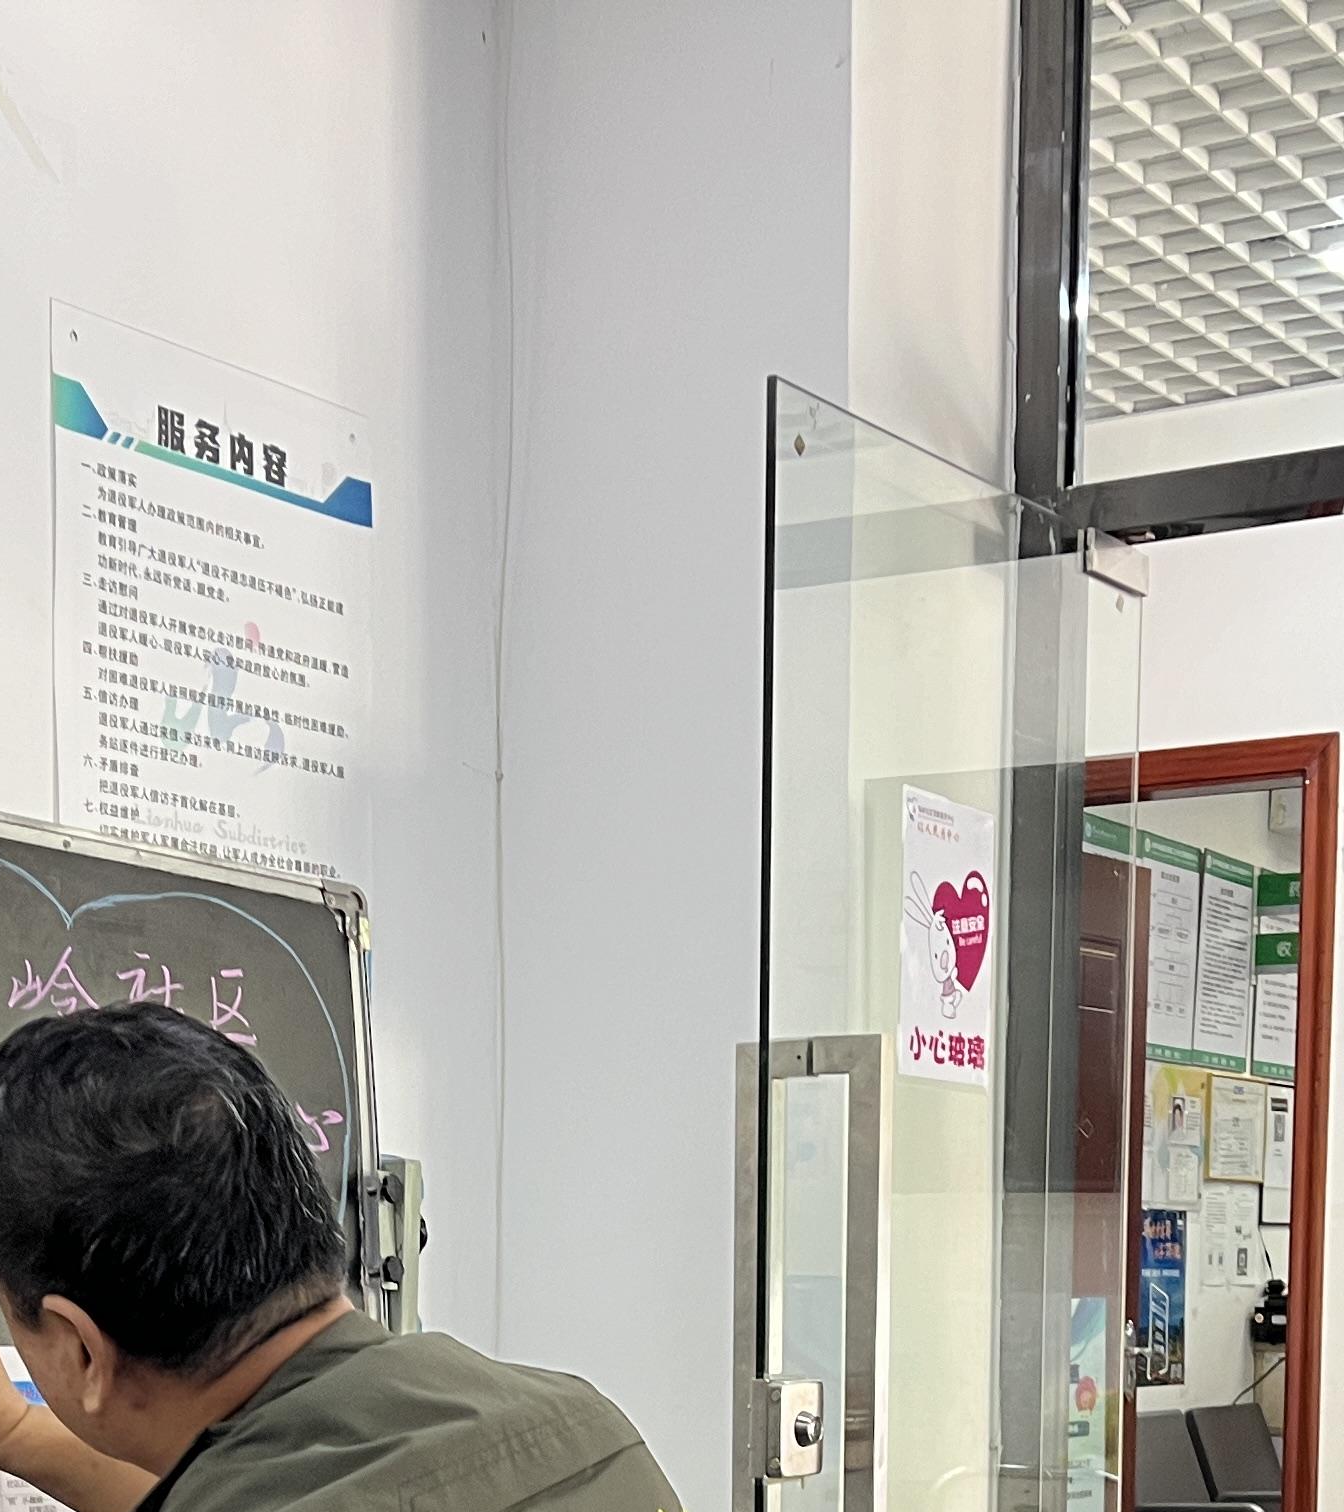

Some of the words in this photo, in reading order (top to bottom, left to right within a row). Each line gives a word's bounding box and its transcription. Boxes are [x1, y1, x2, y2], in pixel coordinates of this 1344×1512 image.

[157, 403, 288, 487] 服务内容
[909, 1025, 985, 1071] 小心玻璃
